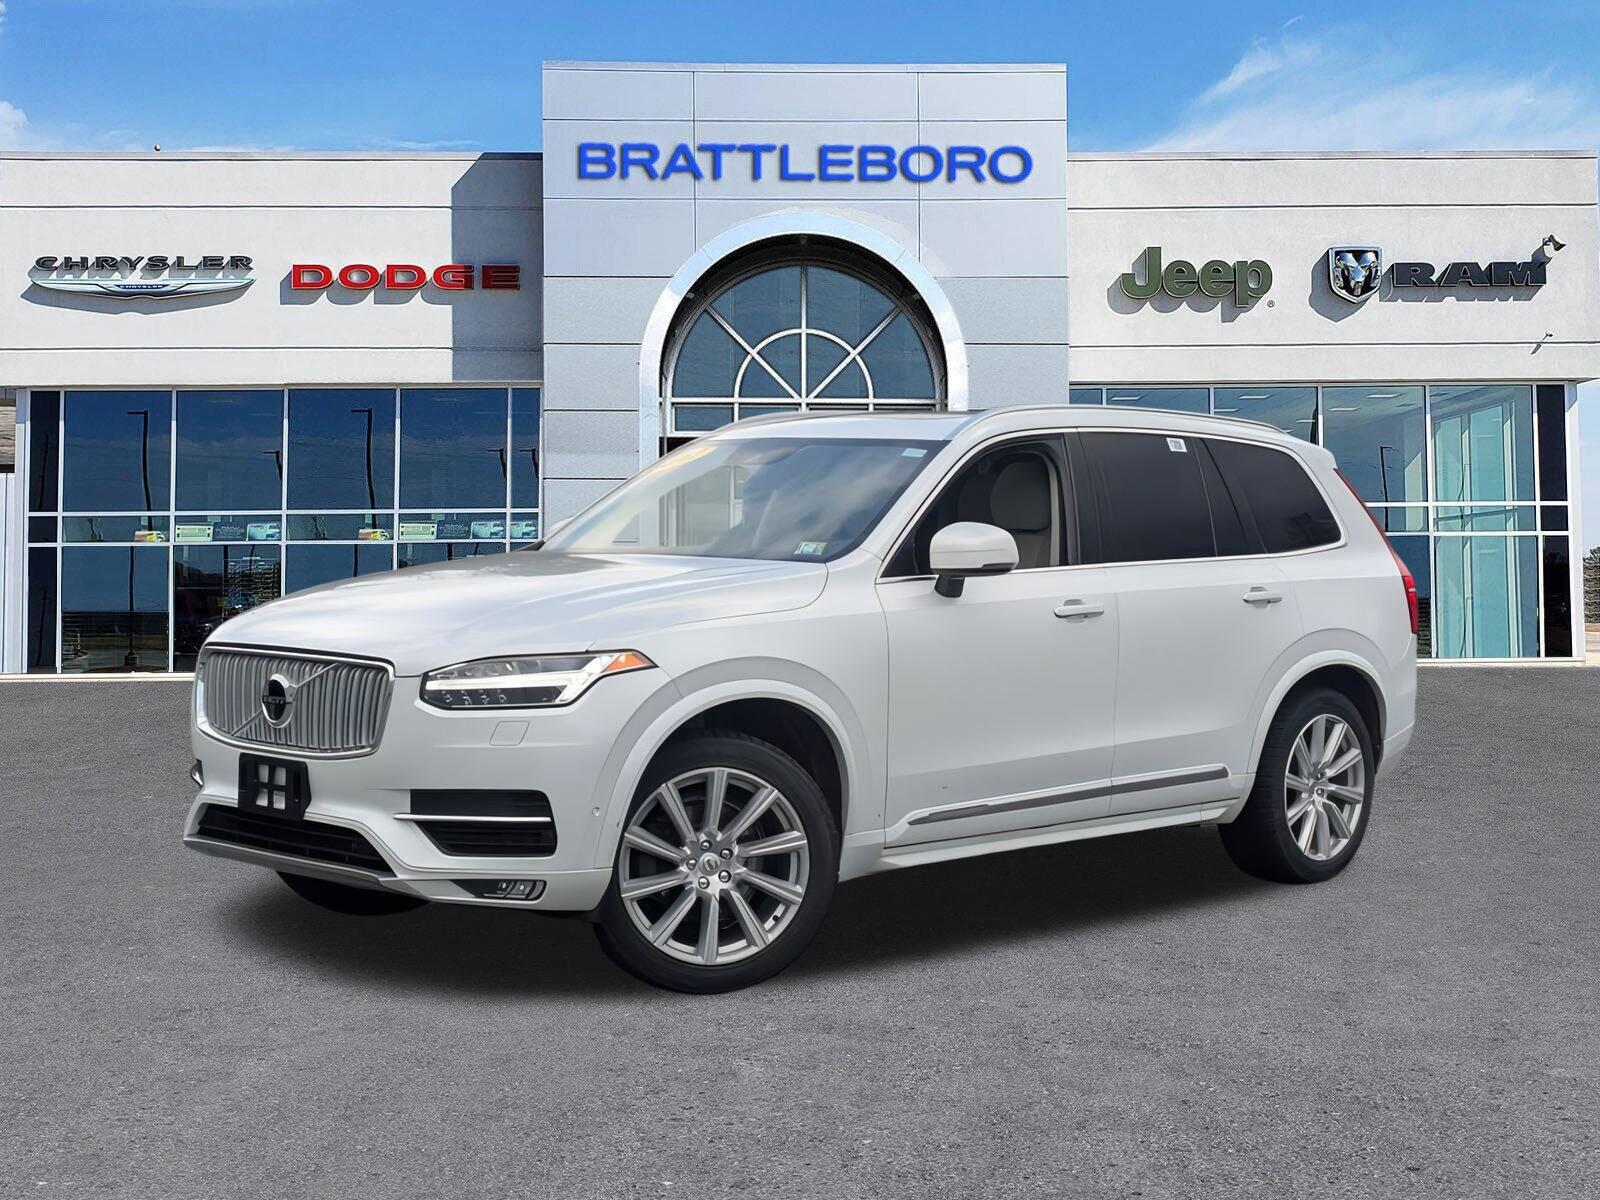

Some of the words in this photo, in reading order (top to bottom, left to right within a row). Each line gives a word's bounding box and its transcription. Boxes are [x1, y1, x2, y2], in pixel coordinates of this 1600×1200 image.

[577, 142, 1034, 185] BRATTLEBORO
[35, 256, 254, 271] CHRYSLER
[1393, 262, 1547, 286] RAM
[292, 264, 520, 290] DODGE
[1121, 247, 1273, 308] Jeep
